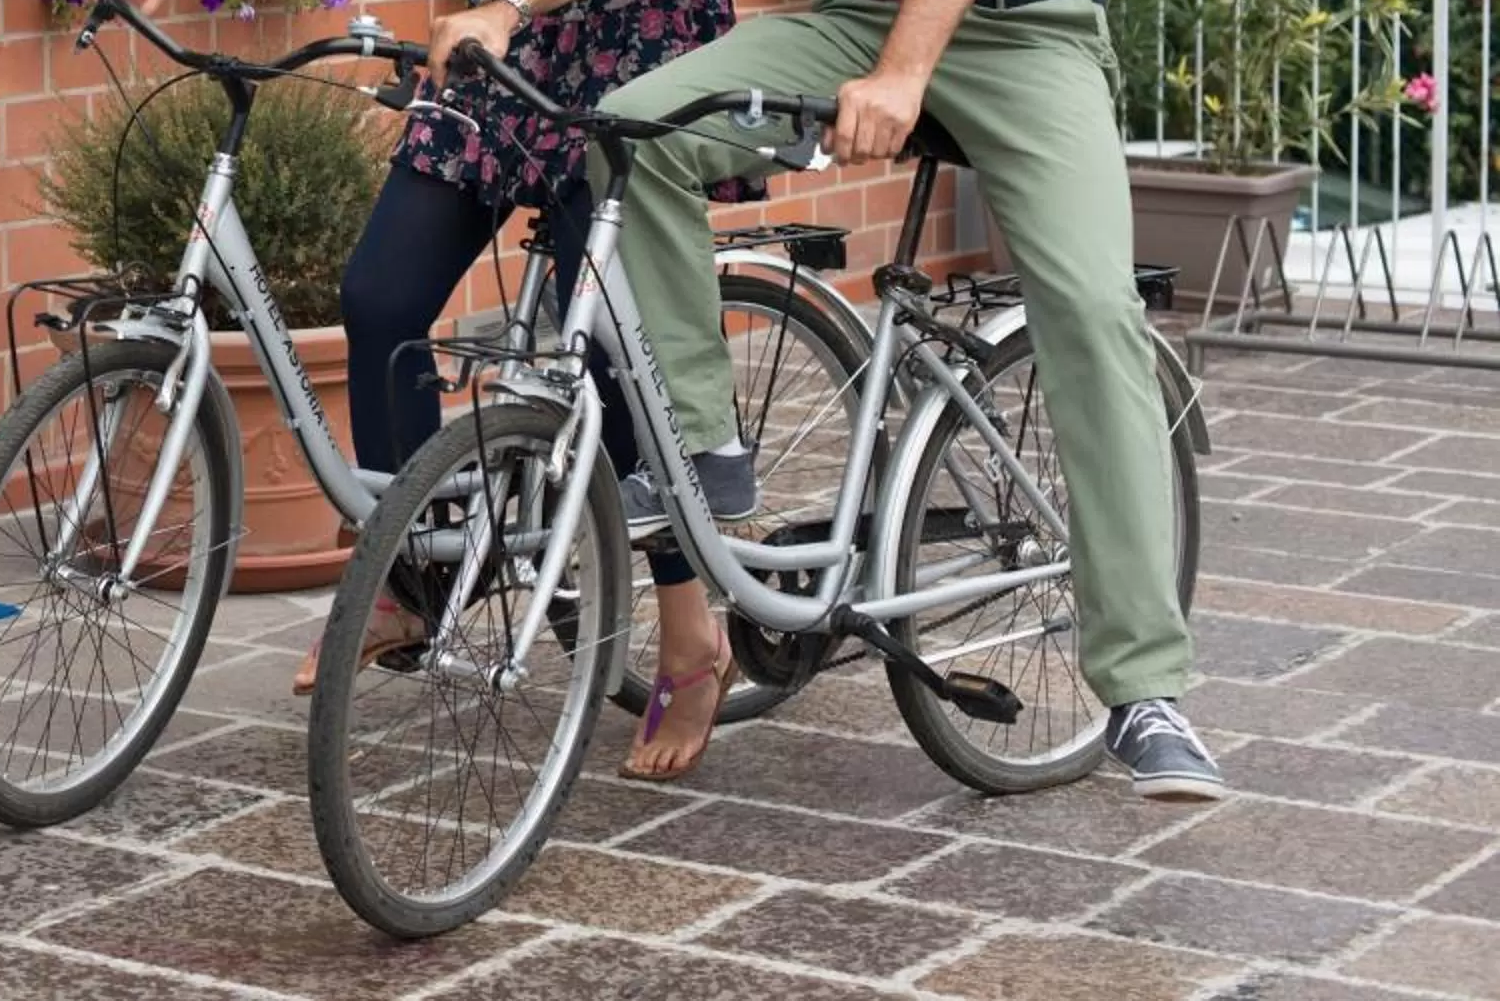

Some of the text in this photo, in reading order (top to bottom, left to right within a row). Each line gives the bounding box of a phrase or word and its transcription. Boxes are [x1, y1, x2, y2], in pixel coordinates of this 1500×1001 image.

[249, 263, 325, 426] HOTEL ASTORIA
[635, 326, 664, 397] HOTEL
